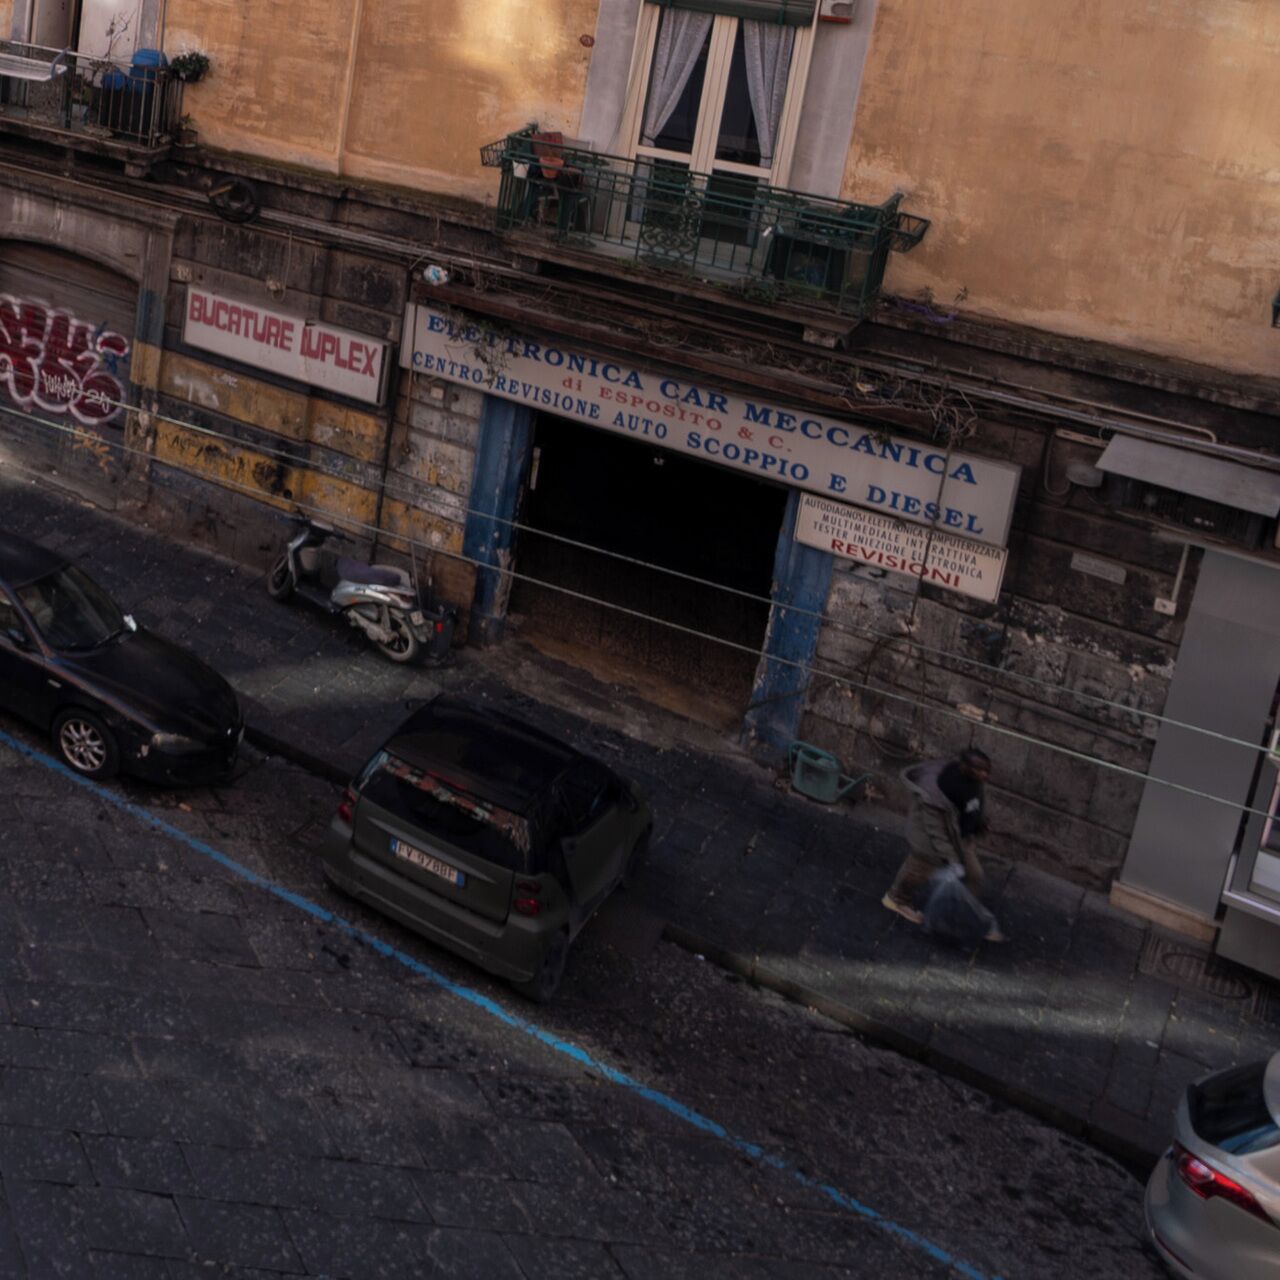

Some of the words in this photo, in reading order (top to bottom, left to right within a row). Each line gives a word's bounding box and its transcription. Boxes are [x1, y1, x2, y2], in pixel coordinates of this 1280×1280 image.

[189, 292, 294, 352] BUCATURE
[562, 376, 582, 392] di
[599, 386, 722, 431] ESPOSITO
[737, 425, 754, 441] &
[659, 379, 729, 414] CAR
[743, 402, 978, 486] MECCANICA
[412, 351, 483, 385] CENTRO
[495, 375, 600, 420] REVISIONE
[612, 411, 668, 439] AUTO
[687, 431, 809, 481] SCOPPIO
[828, 473, 847, 493] E
[866, 484, 984, 535] DIESEL
[813, 521, 848, 539] TESTER
[852, 533, 906, 557] INIEZIONE
[822, 513, 900, 543] MULTIMEDIALE
[905, 537, 977, 566] INTRATTIVA
[830, 538, 961, 588] REVISIONI
